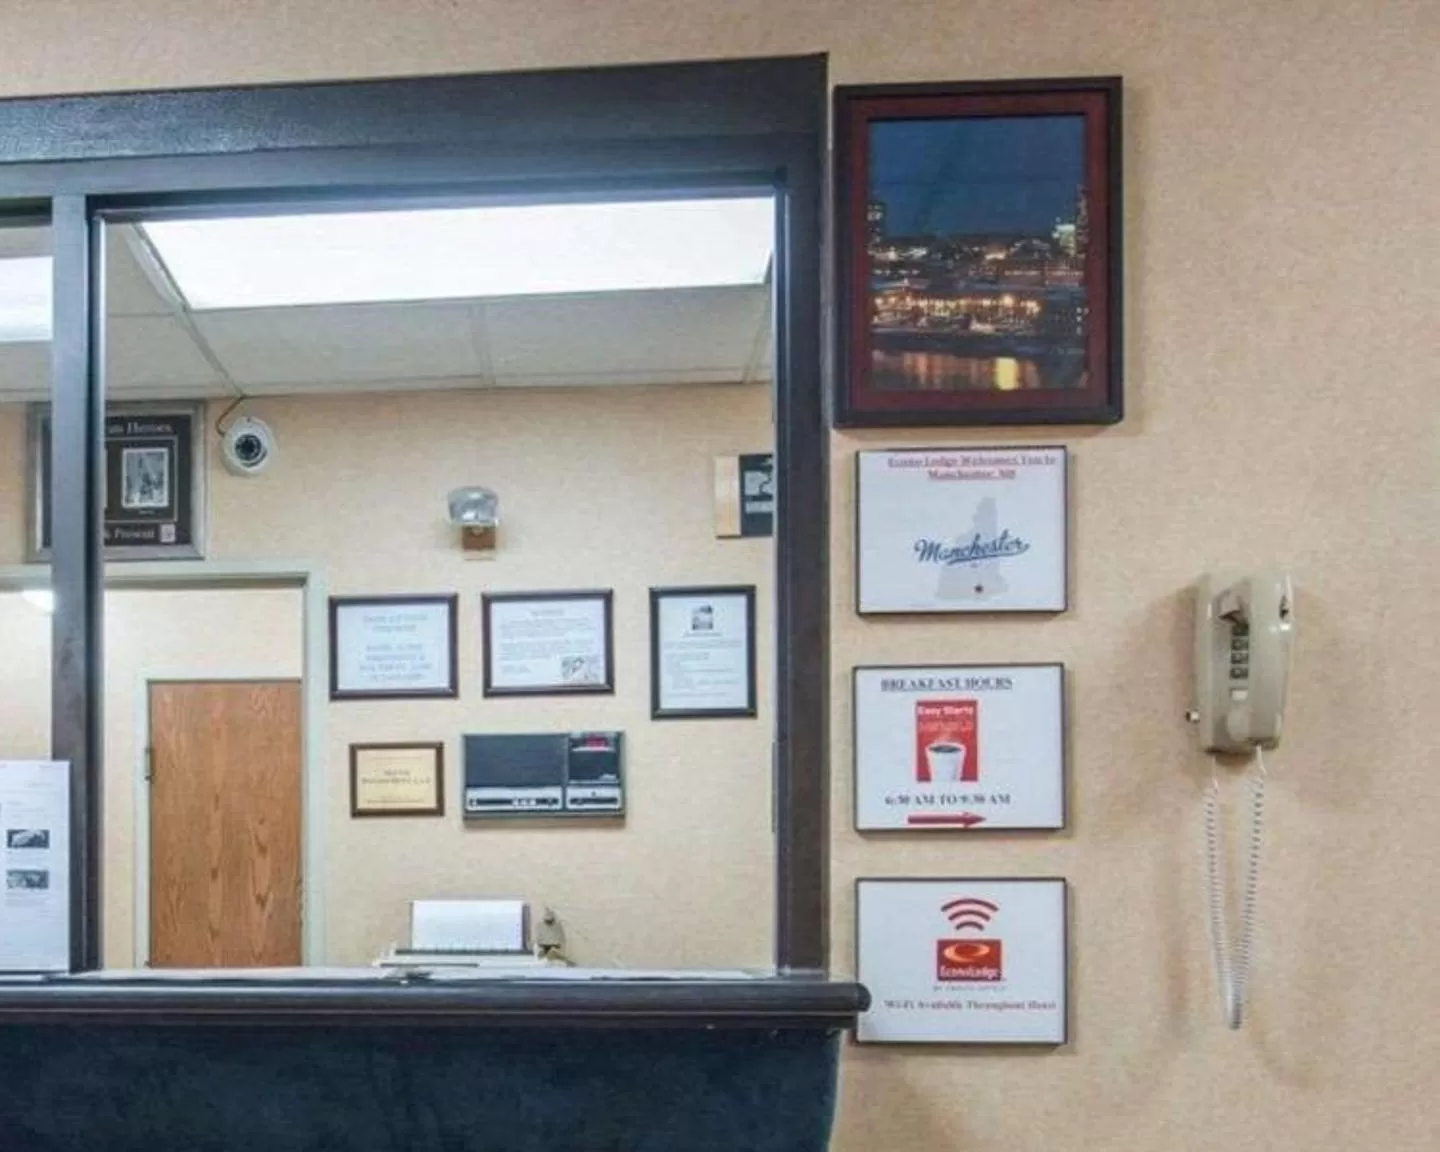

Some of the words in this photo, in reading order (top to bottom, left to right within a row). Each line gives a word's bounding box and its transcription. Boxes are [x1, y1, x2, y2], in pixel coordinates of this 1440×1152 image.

[924, 456, 958, 467] Lodge
[913, 529, 1031, 565] Manchester
[880, 677, 960, 691] BREAKFAST
[964, 676, 1013, 690] HOURS
[914, 793, 935, 805] AM
[939, 793, 957, 804] TO
[989, 793, 1011, 804] AM
